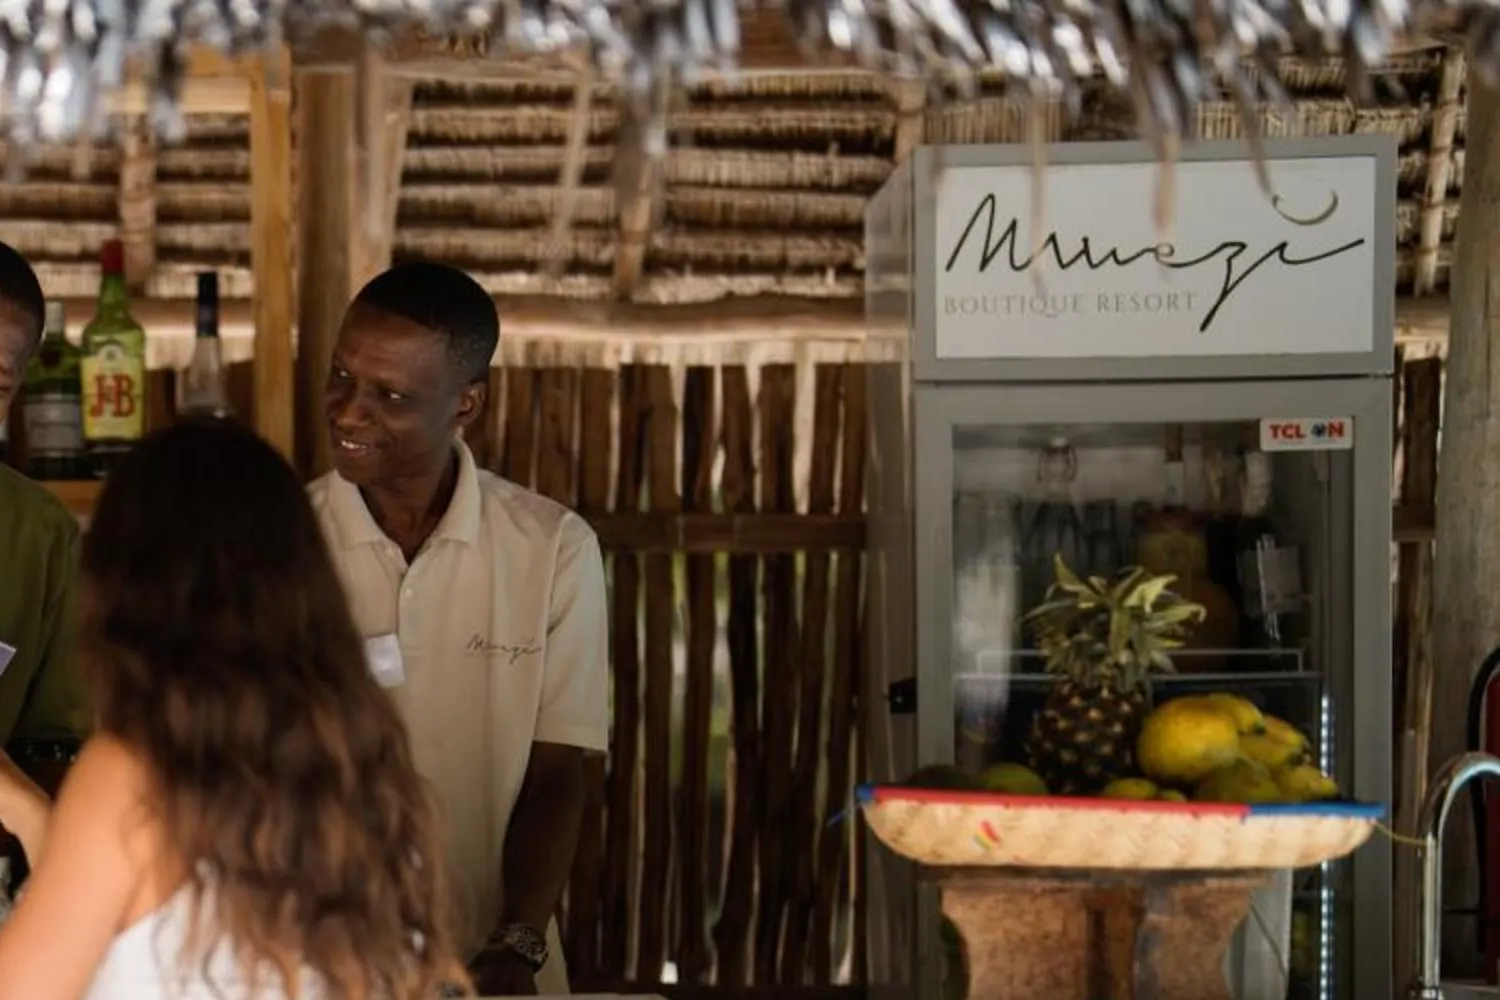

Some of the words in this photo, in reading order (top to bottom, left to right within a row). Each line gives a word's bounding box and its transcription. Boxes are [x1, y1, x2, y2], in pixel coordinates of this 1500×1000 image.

[944, 294, 1084, 318] BOUTIQUE
[1097, 291, 1197, 314] RESORT
[1268, 423, 1306, 439] TCL
